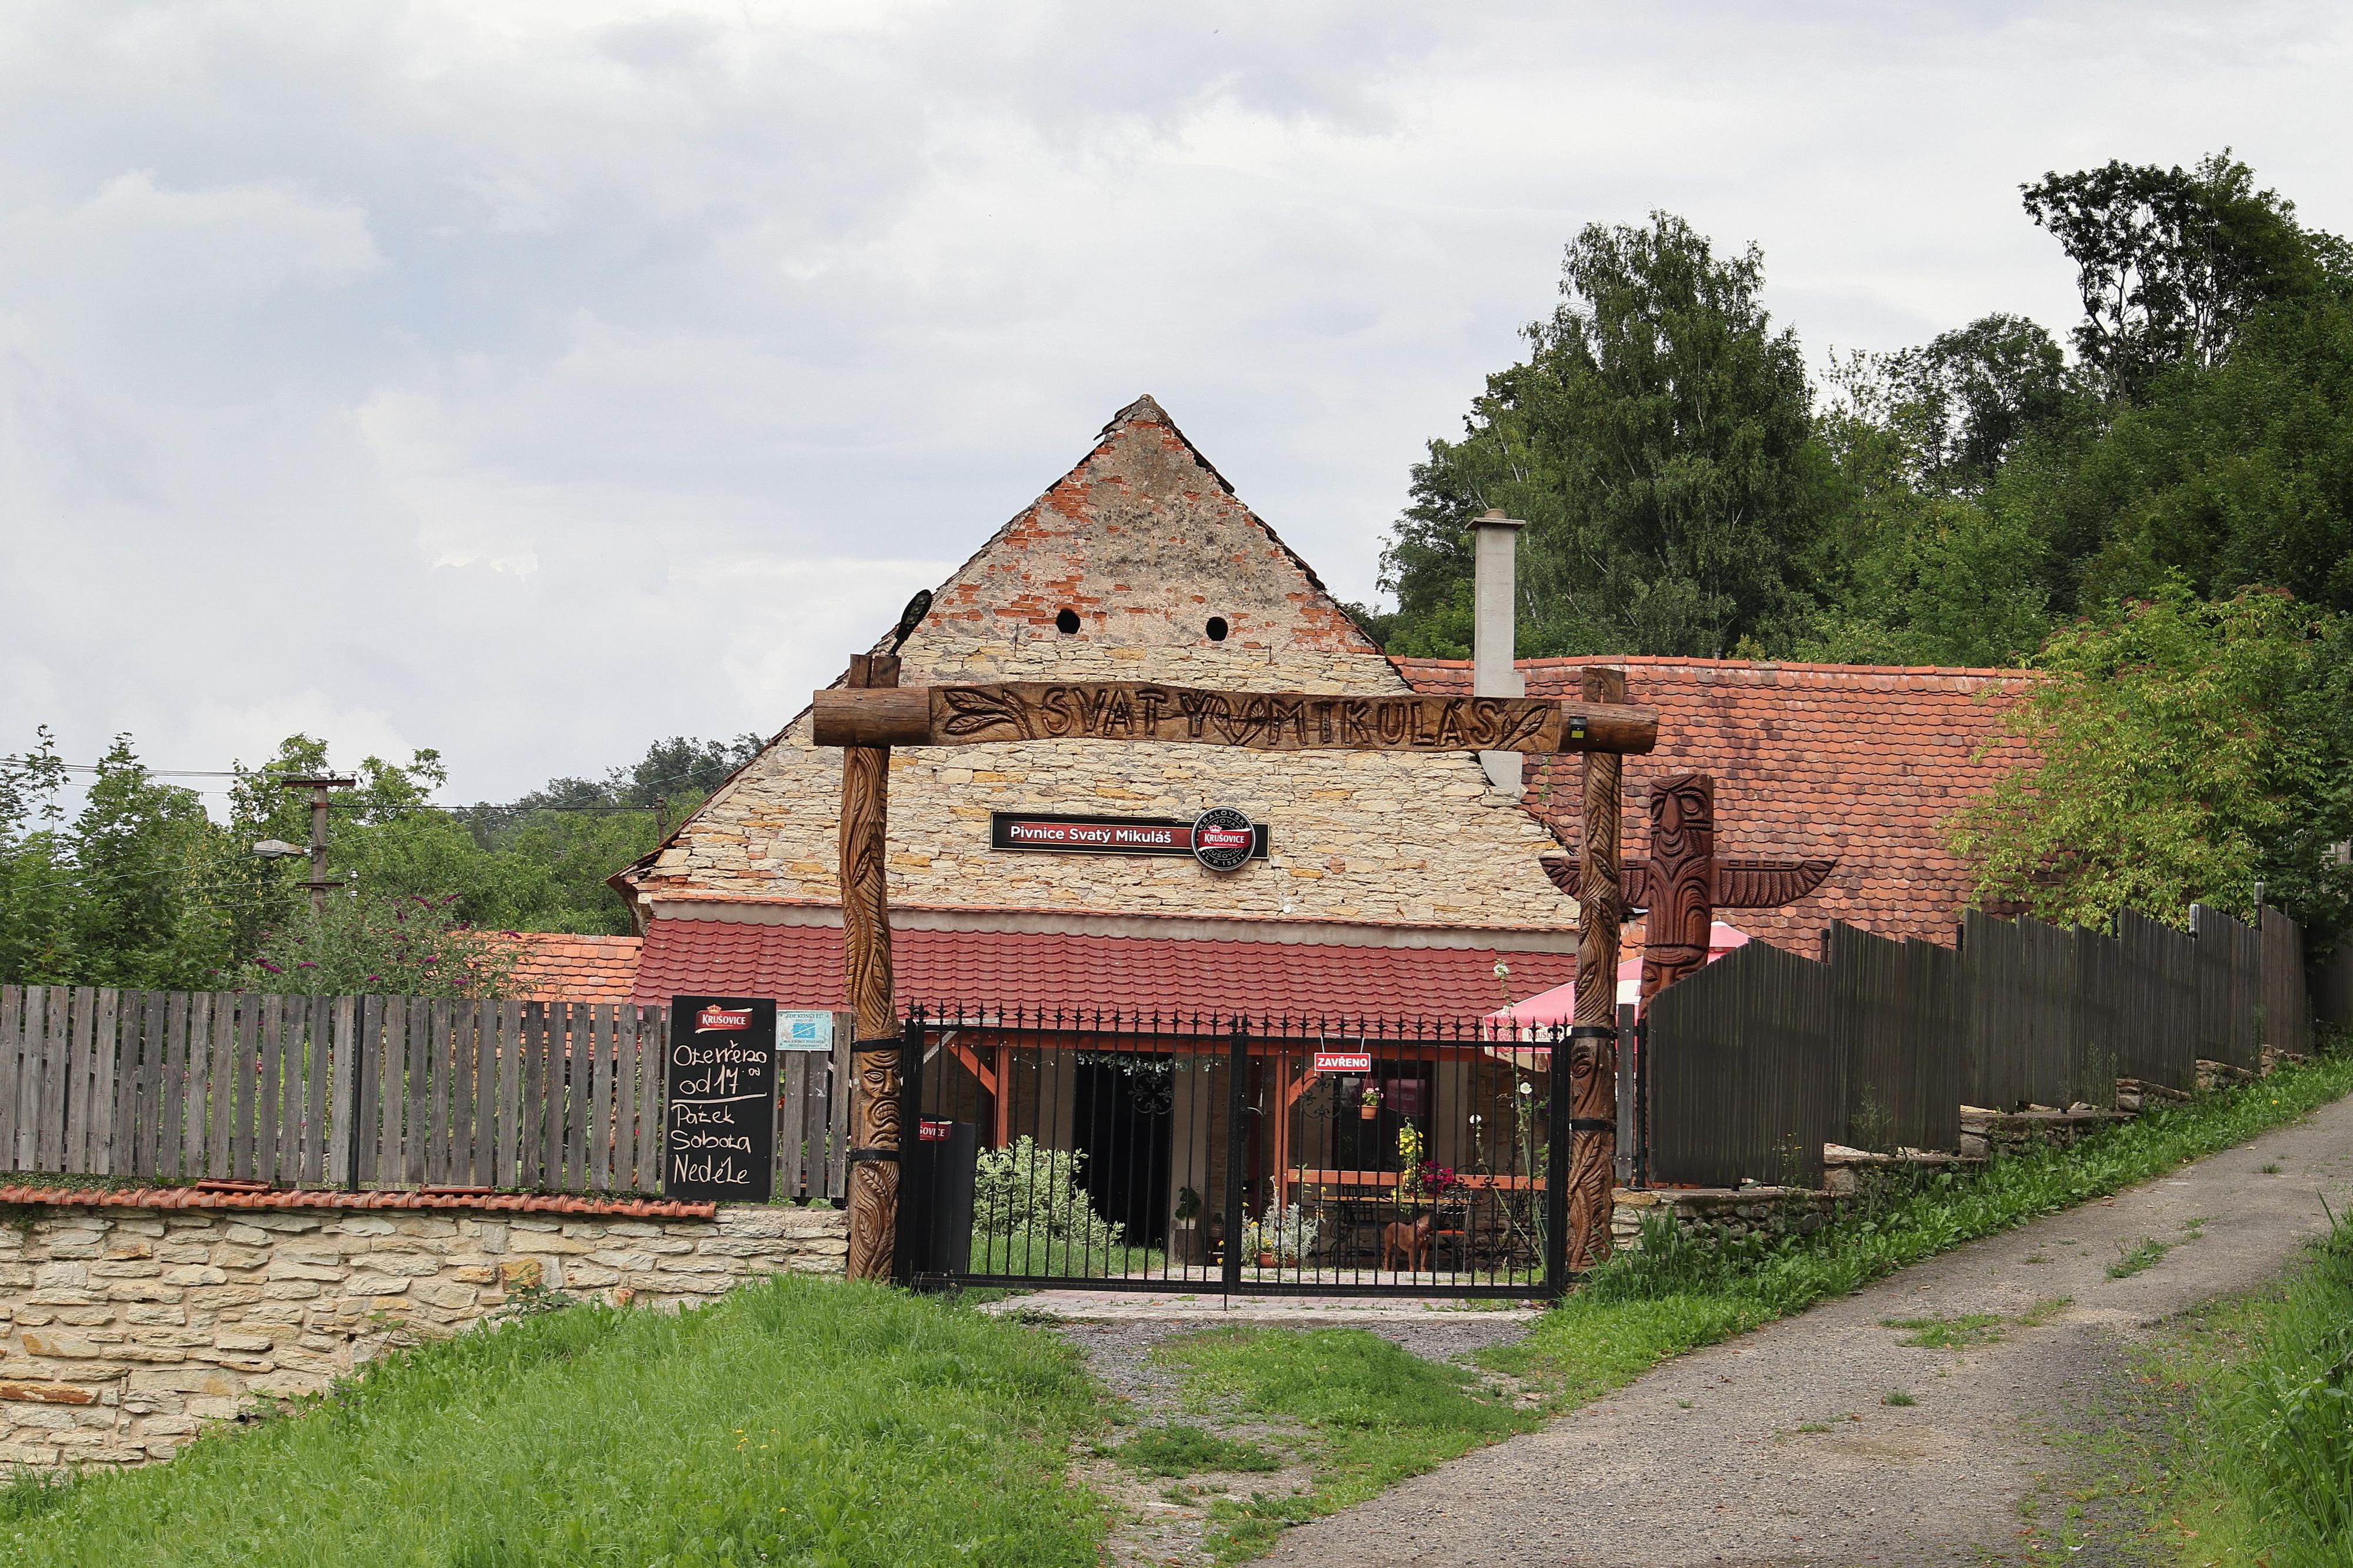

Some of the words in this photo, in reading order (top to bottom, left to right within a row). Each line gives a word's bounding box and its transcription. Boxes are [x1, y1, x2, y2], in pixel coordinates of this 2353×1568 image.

[1010, 826, 1065, 840] Pivnice
[1069, 828, 1111, 843] Svatý
[1115, 830, 1172, 843] Mikuláš
[1204, 833, 1245, 844] KRUŠOVICE
[1222, 856, 1241, 866] 1581
[702, 1014, 746, 1026] KRUŠOVICE
[1318, 1056, 1368, 1067] ZAVŘENO
[679, 1067, 711, 1095] od
[671, 1130, 752, 1153] Sobota
[674, 1154, 751, 1184] Neděle
